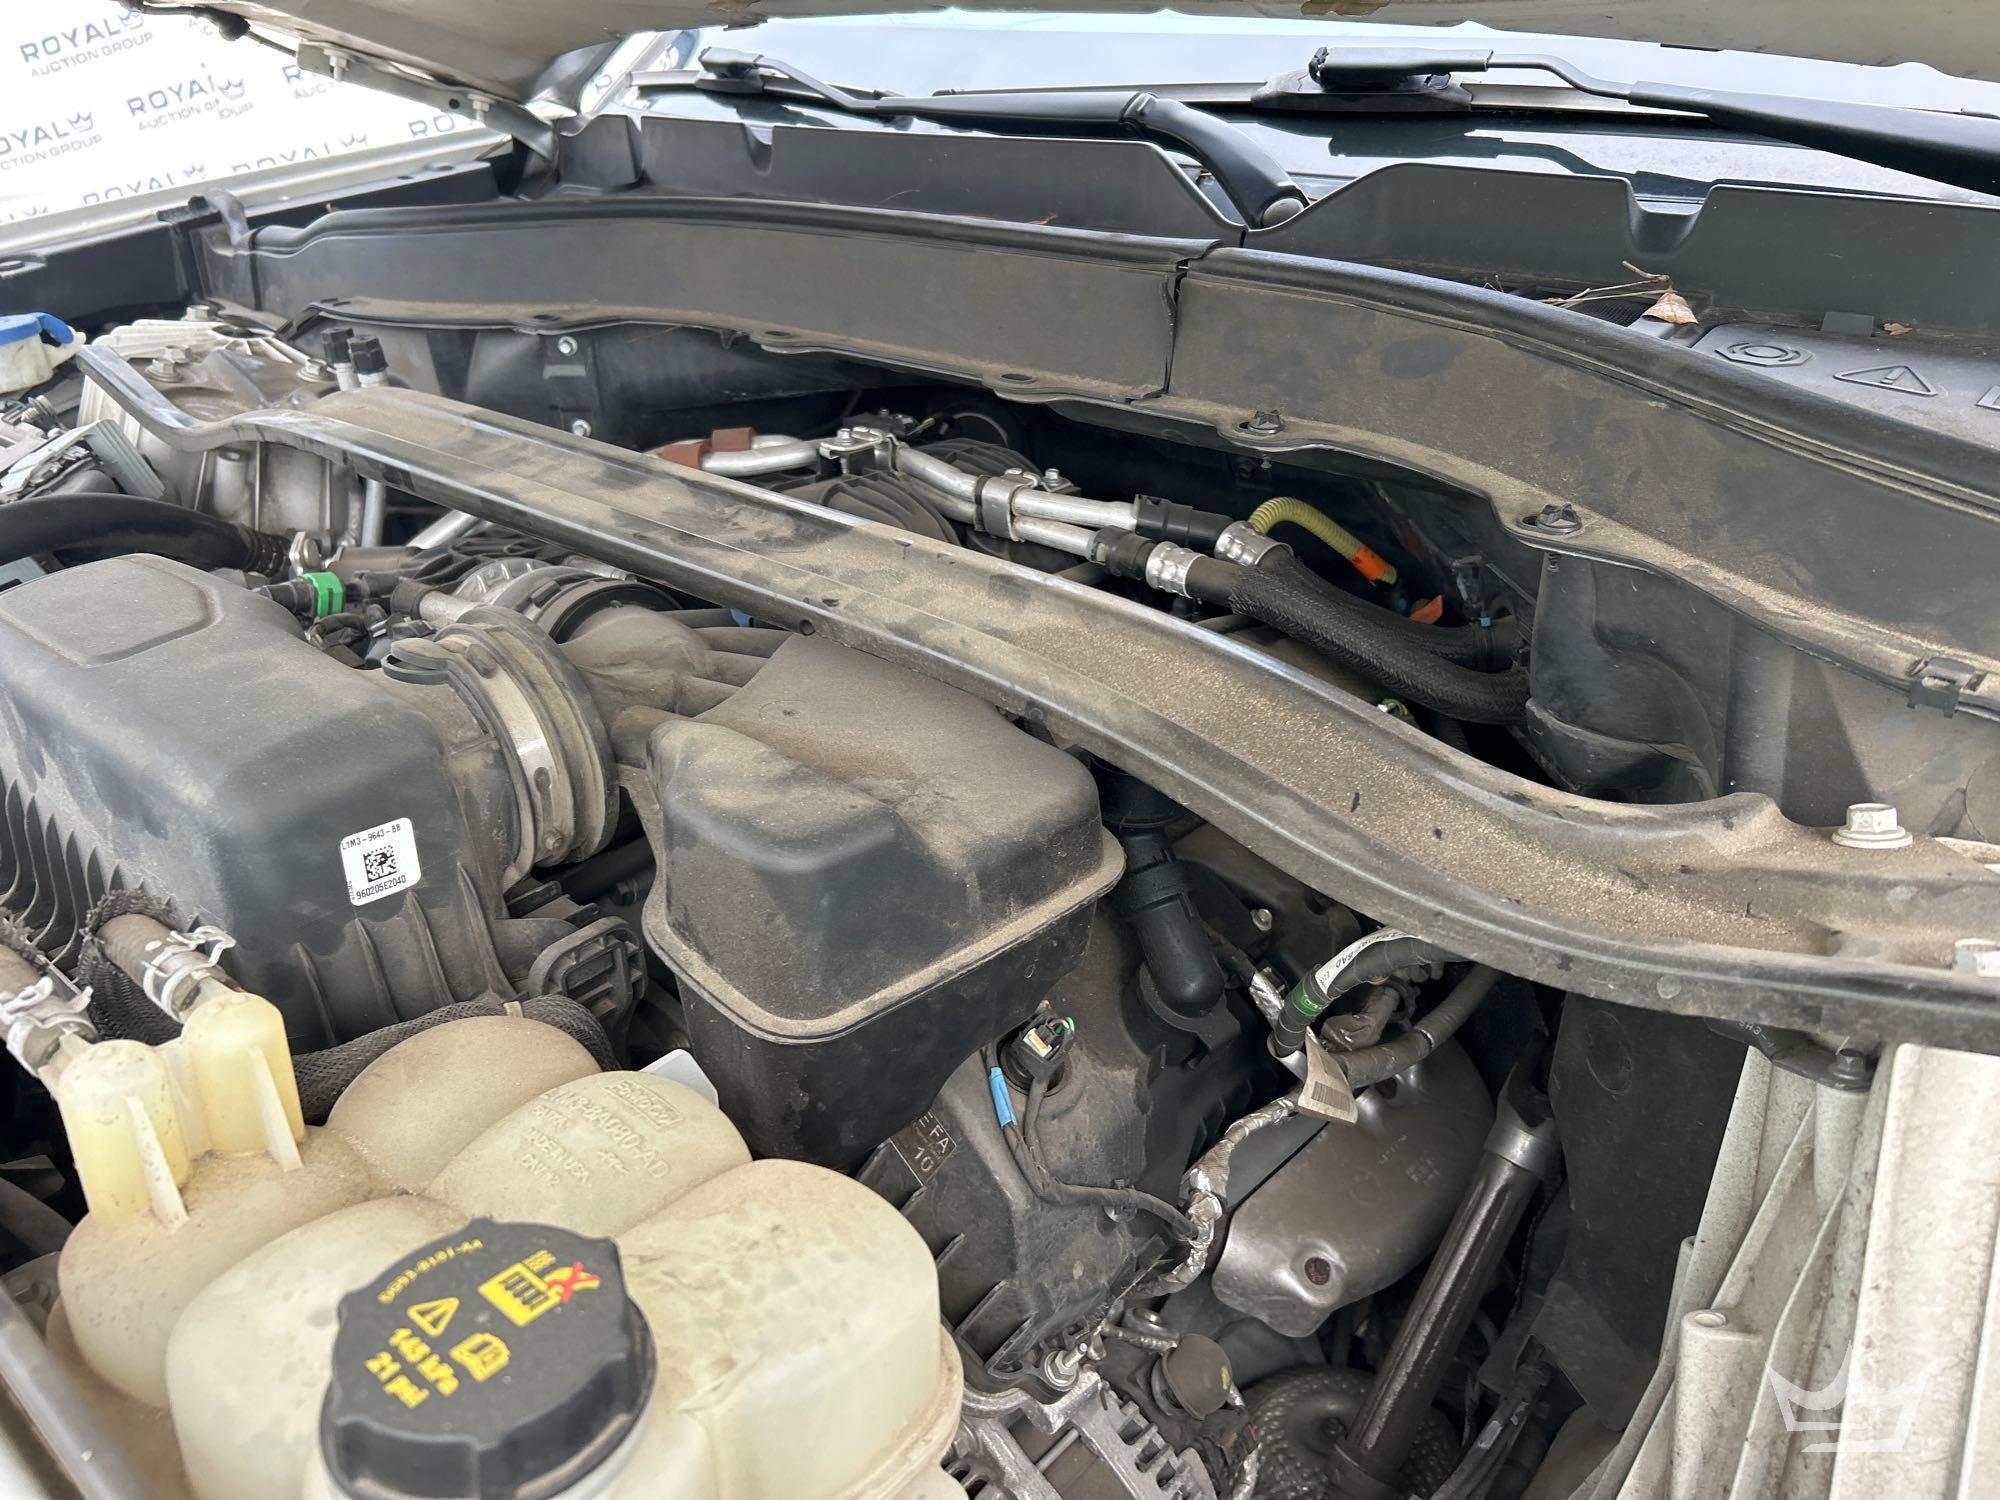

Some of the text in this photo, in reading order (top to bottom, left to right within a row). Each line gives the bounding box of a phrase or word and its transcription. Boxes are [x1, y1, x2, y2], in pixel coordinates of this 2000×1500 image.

[19, 18, 122, 63] ROYAL
[31, 31, 154, 78] AUCTION GROUP
[0, 122, 71, 155] OYAL
[0, 134, 103, 171] CTION GROUP
[915, 1146, 935, 1173] 10
